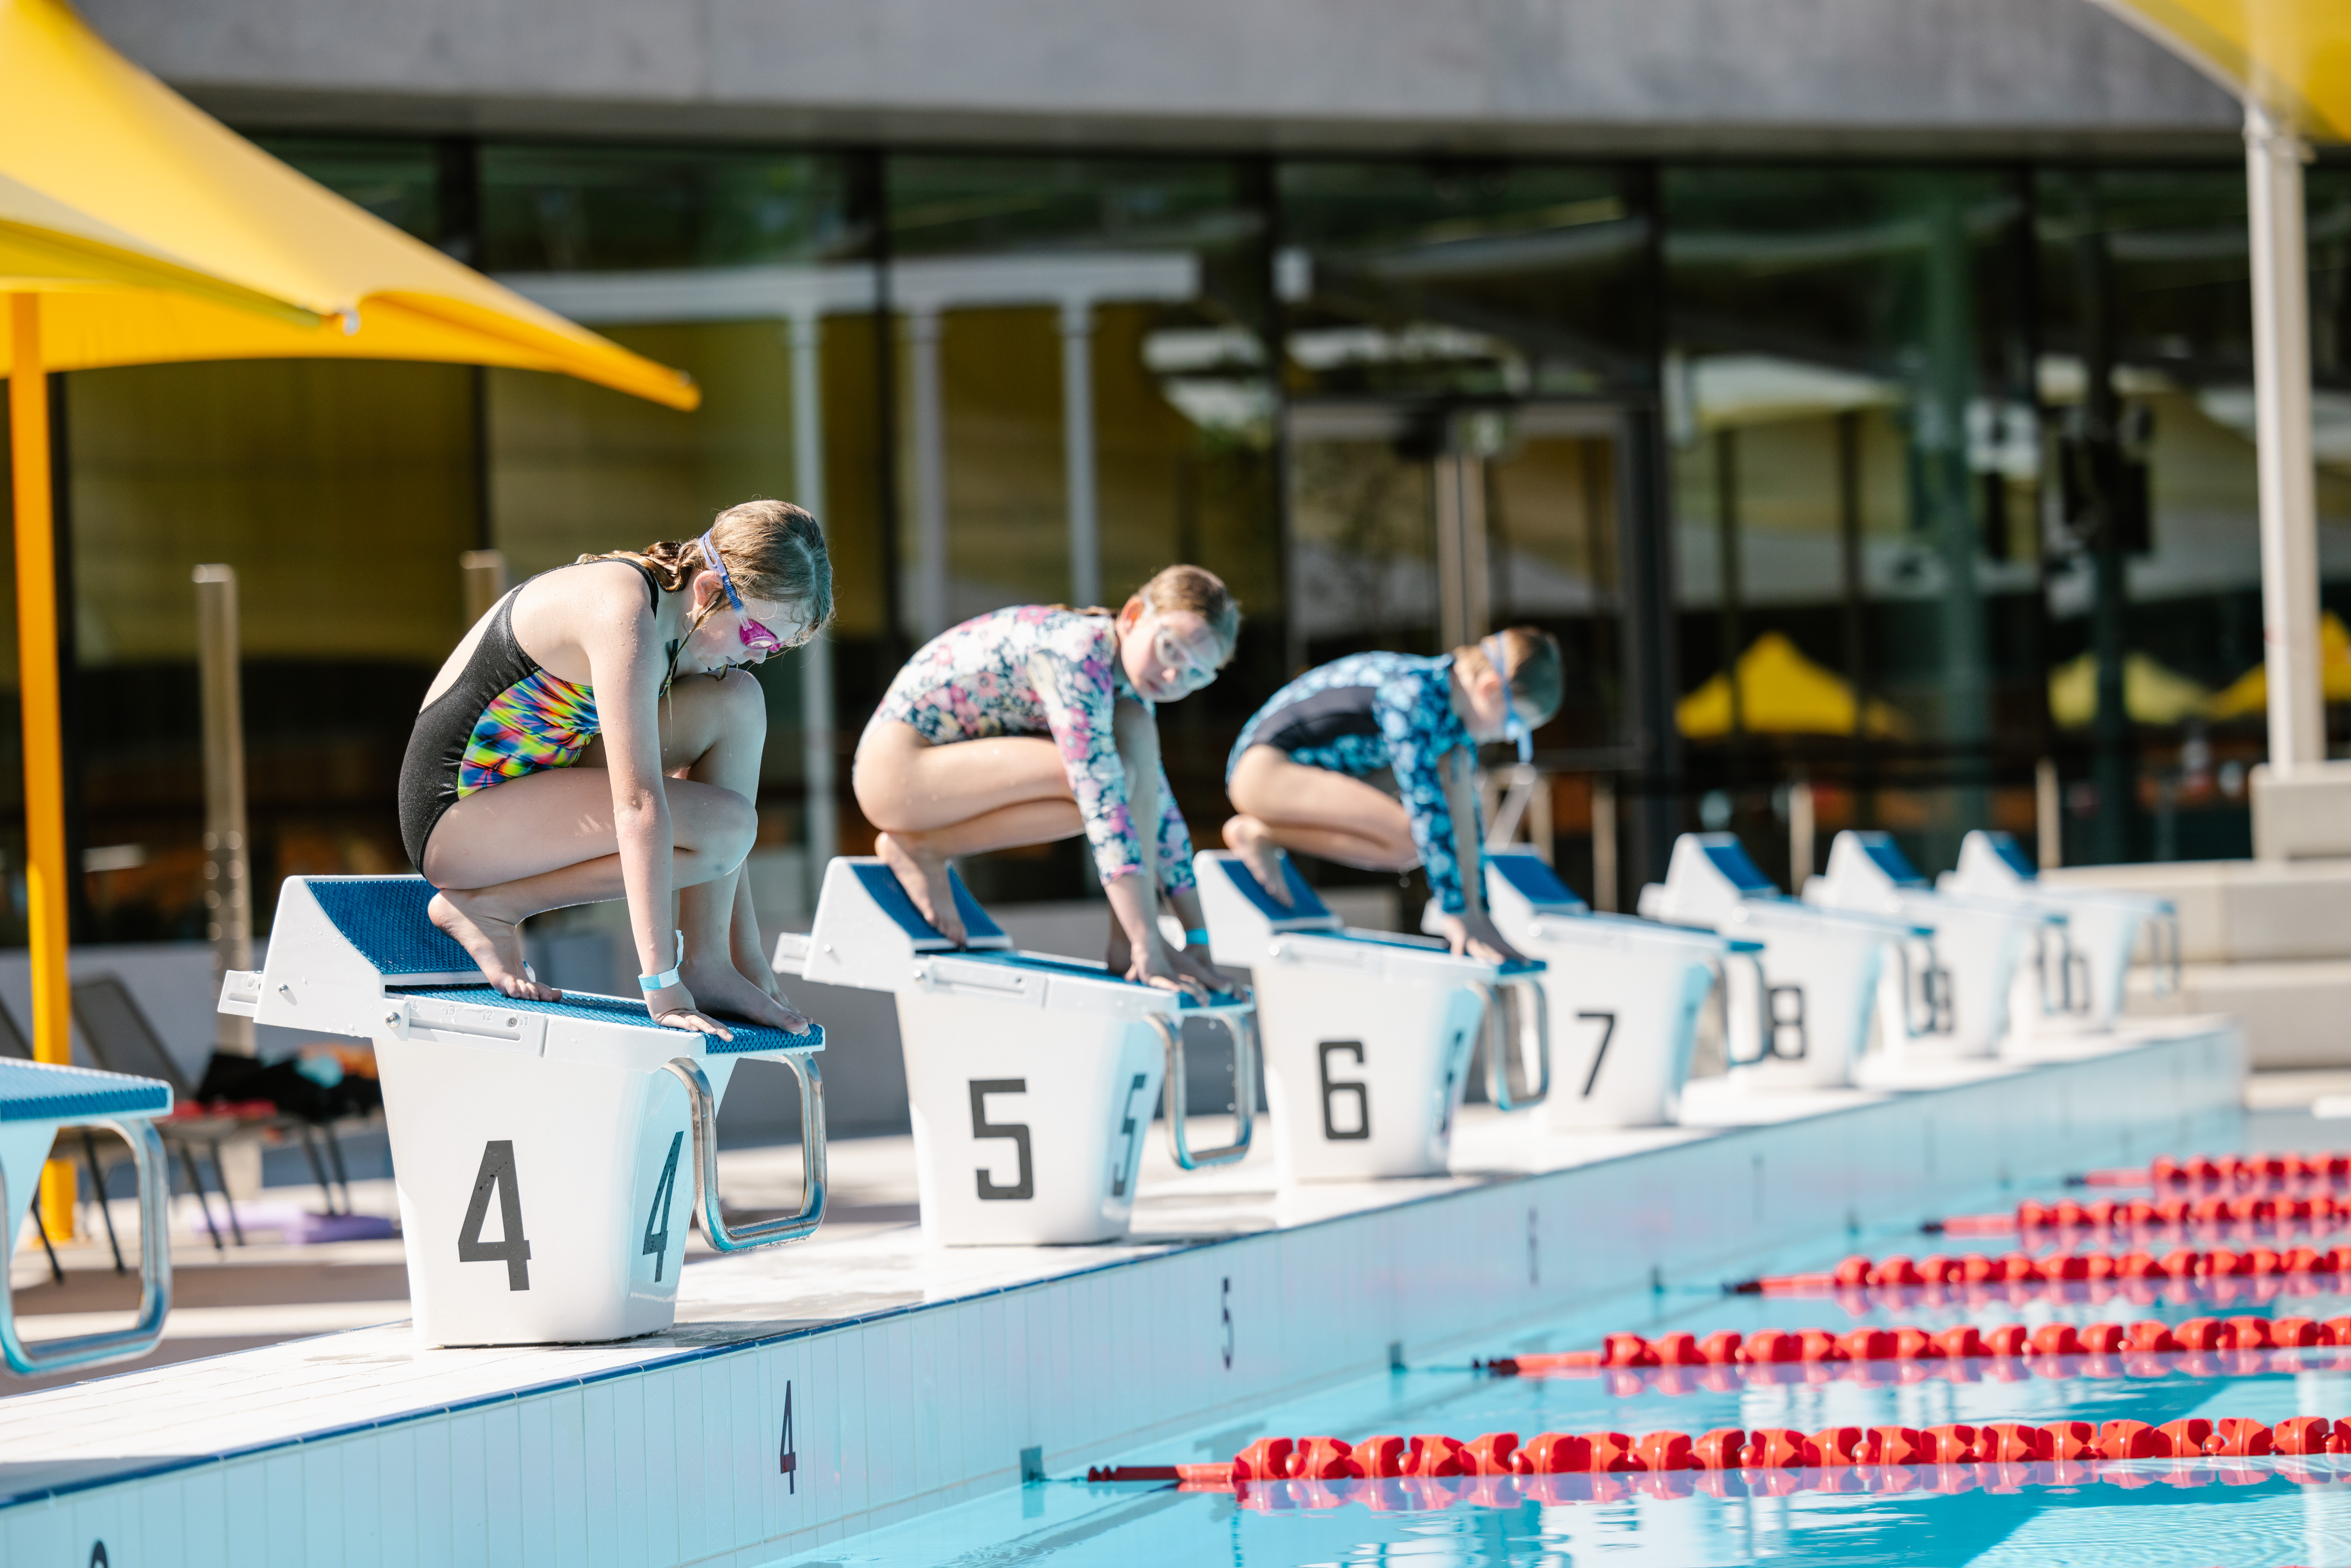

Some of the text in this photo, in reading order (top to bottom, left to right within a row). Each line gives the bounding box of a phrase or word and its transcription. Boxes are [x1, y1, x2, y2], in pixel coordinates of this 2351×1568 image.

[1576, 1013, 1615, 1096] 7
[1766, 985, 1806, 1060] 8
[969, 1078, 1034, 1200] 5
[1113, 1074, 1146, 1196] 5
[1319, 1041, 1370, 1140] 6
[458, 1140, 532, 1291] 4
[643, 1130, 684, 1283] 4
[780, 1379, 796, 1495] 4
